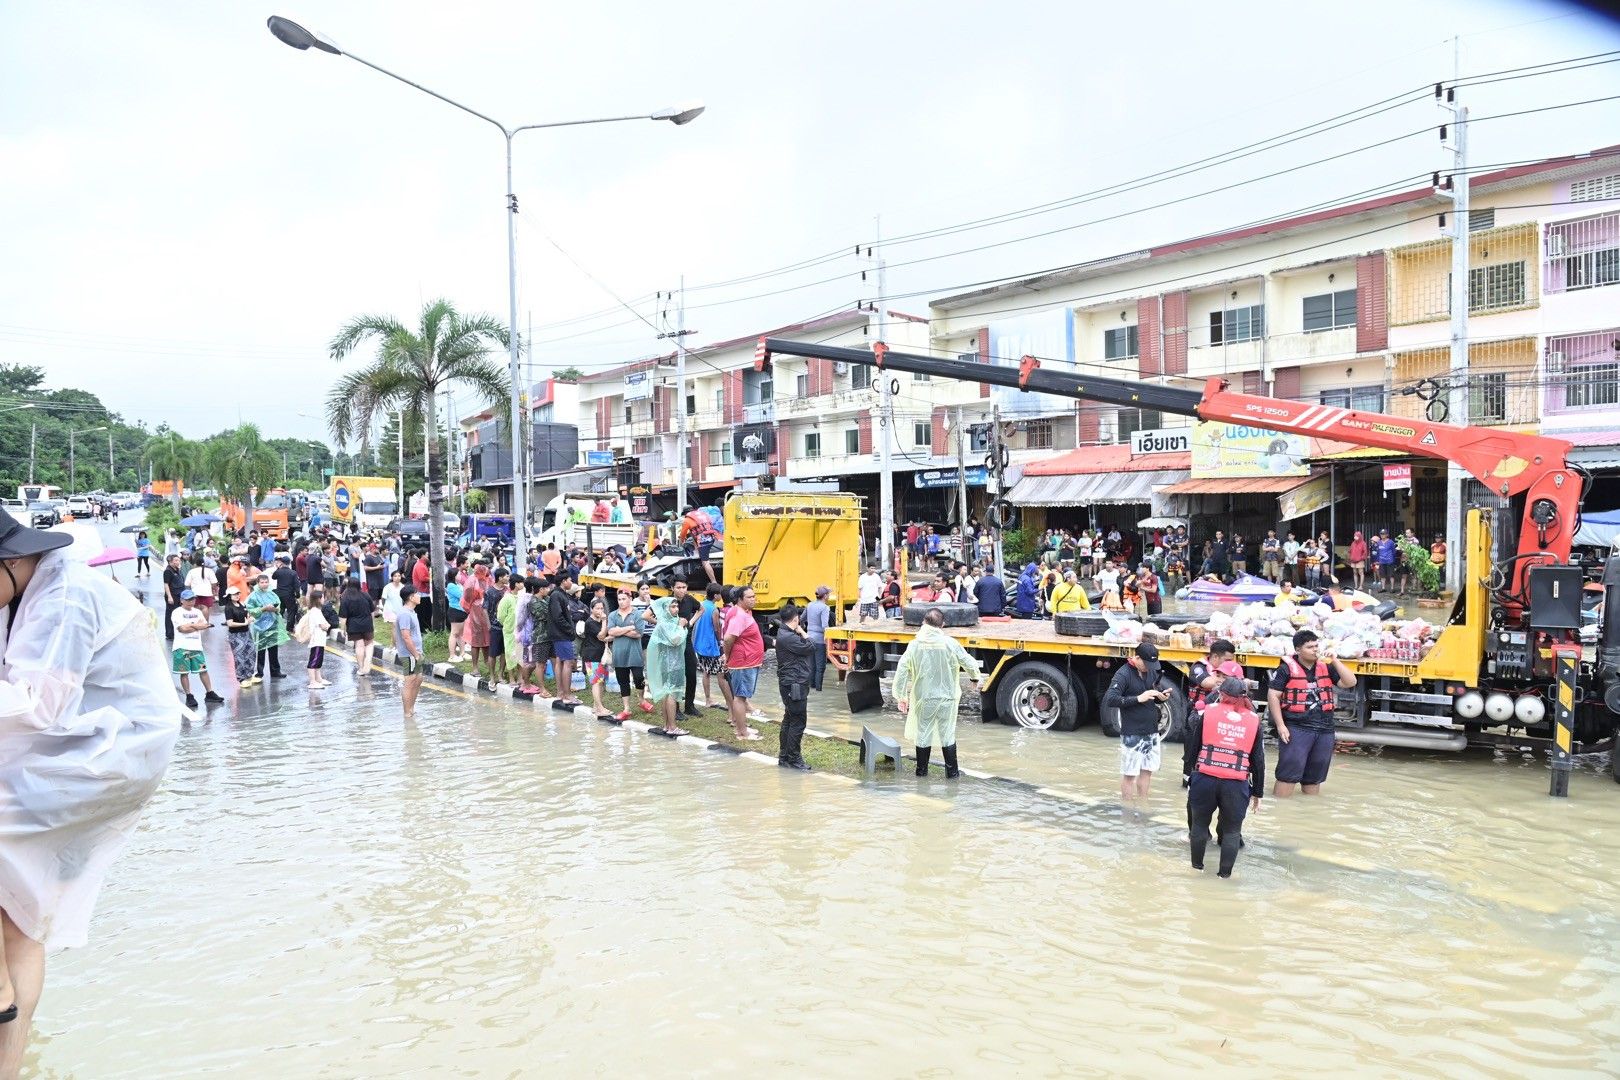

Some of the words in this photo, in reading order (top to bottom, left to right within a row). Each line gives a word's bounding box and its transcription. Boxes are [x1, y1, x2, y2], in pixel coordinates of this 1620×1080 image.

[1246, 403, 1262, 413] SPS
[1263, 407, 1289, 417] 12500
[1341, 419, 1370, 430] SANY
[1371, 423, 1414, 436] PALFINGER
[1138, 433, 1187, 452] เฮียเขา
[1217, 722, 1246, 733] REFUSE
[1227, 730, 1245, 738] SINK
